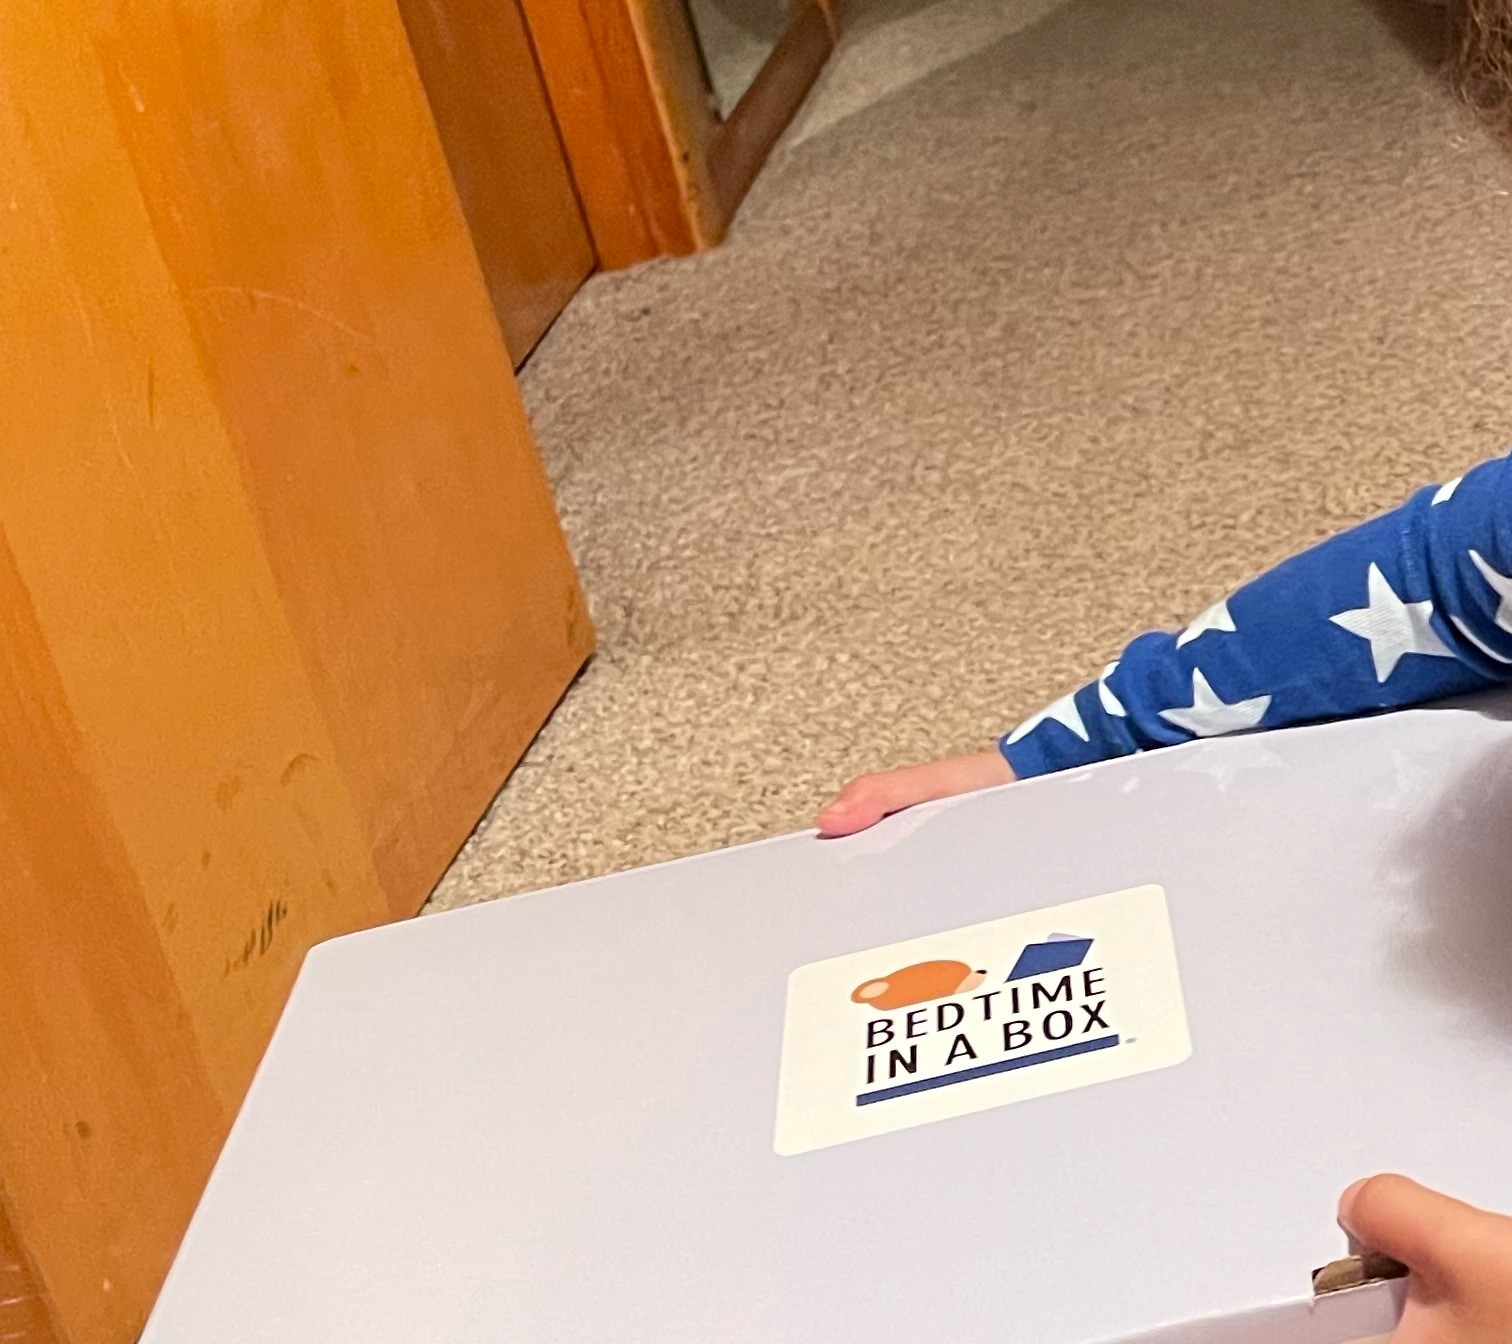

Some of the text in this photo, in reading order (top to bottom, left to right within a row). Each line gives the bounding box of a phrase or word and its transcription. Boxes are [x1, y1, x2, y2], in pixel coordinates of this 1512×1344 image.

[866, 967, 1107, 1049] BEDTIME
[866, 1000, 1110, 1085] IN A BOX
